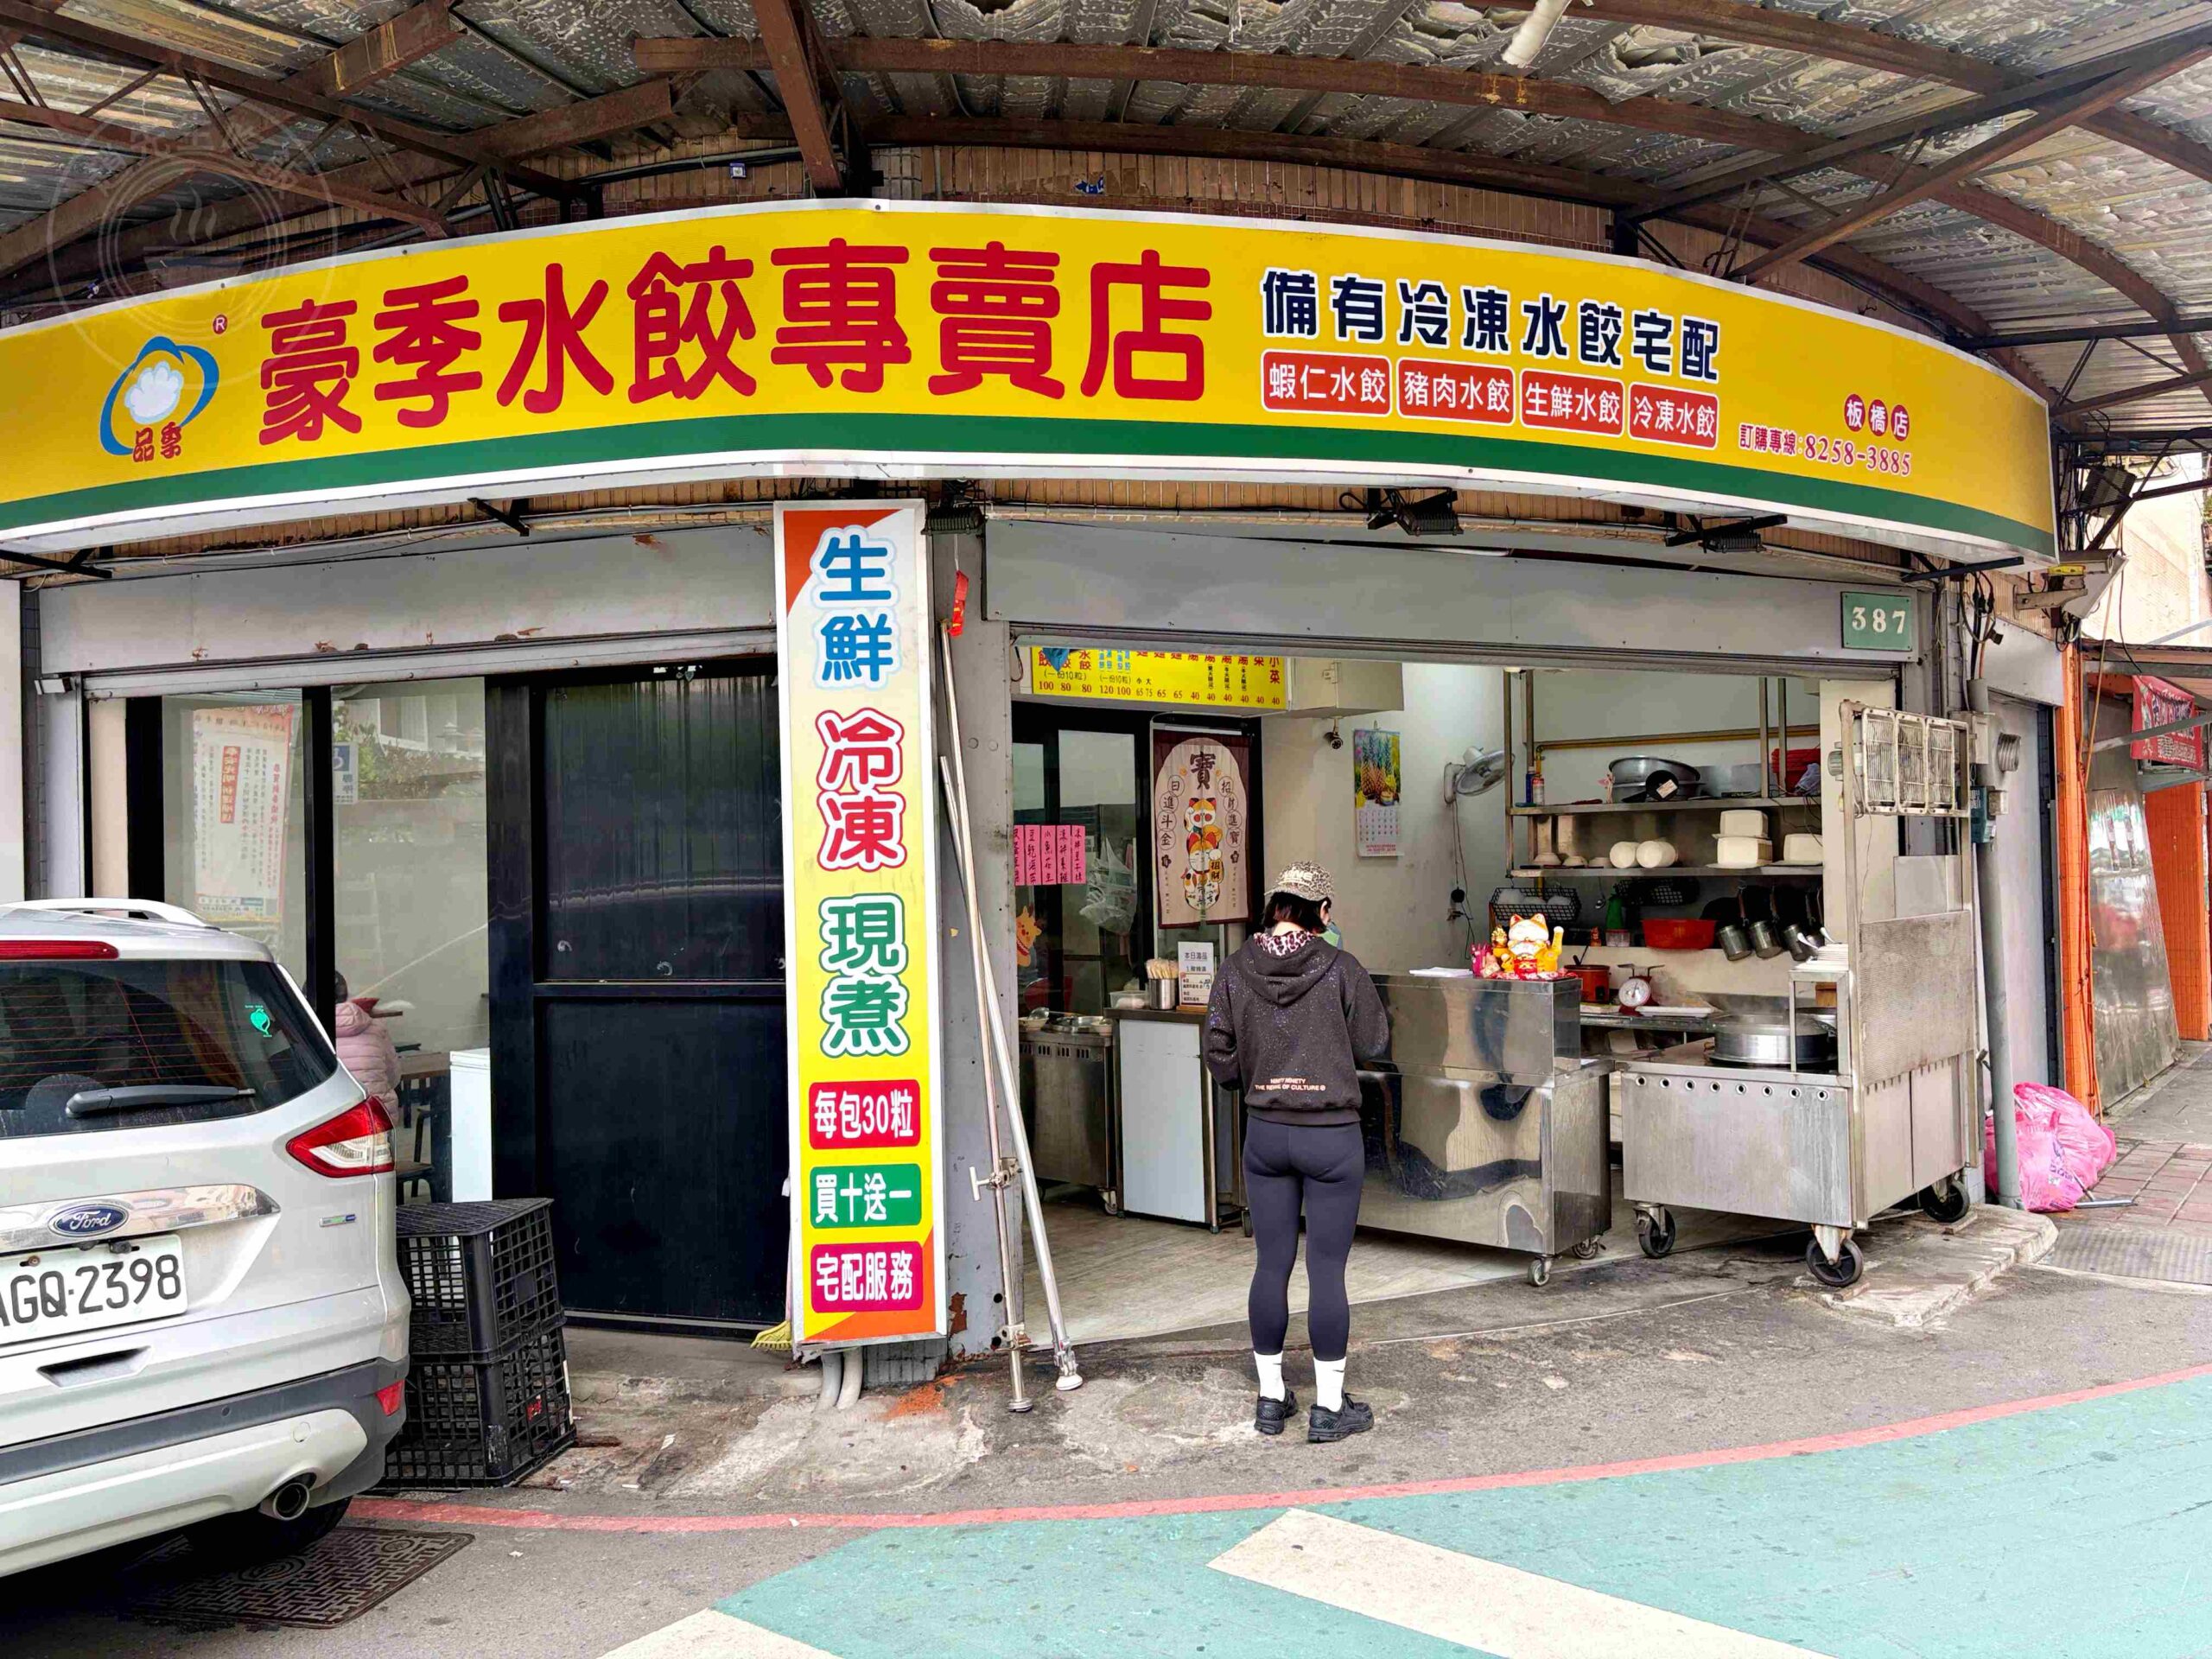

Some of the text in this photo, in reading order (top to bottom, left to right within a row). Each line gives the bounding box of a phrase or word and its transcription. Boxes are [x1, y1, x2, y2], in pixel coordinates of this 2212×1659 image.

[259, 238, 1212, 446] 豪季水餃專賣店
[1262, 270, 1718, 382] 備有冷凍水餃宅配
[1268, 362, 1386, 404] 蝦仁水餃
[1403, 371, 1510, 412] 豬肉水餃
[1525, 381, 1621, 426] 生鮮水餃
[1633, 395, 1715, 438] 冷凍水餃
[1846, 398, 1910, 439] 板橋店
[1852, 607, 1906, 633] 387
[1190, 751, 1216, 790] 寶
[1160, 780, 1180, 846] 日進斗金
[814, 1089, 913, 1139] 每包30粒
[69, 1211, 111, 1230] Ford
[816, 1173, 912, 1224] 買十送一
[816, 1249, 913, 1302] 宅配服務
